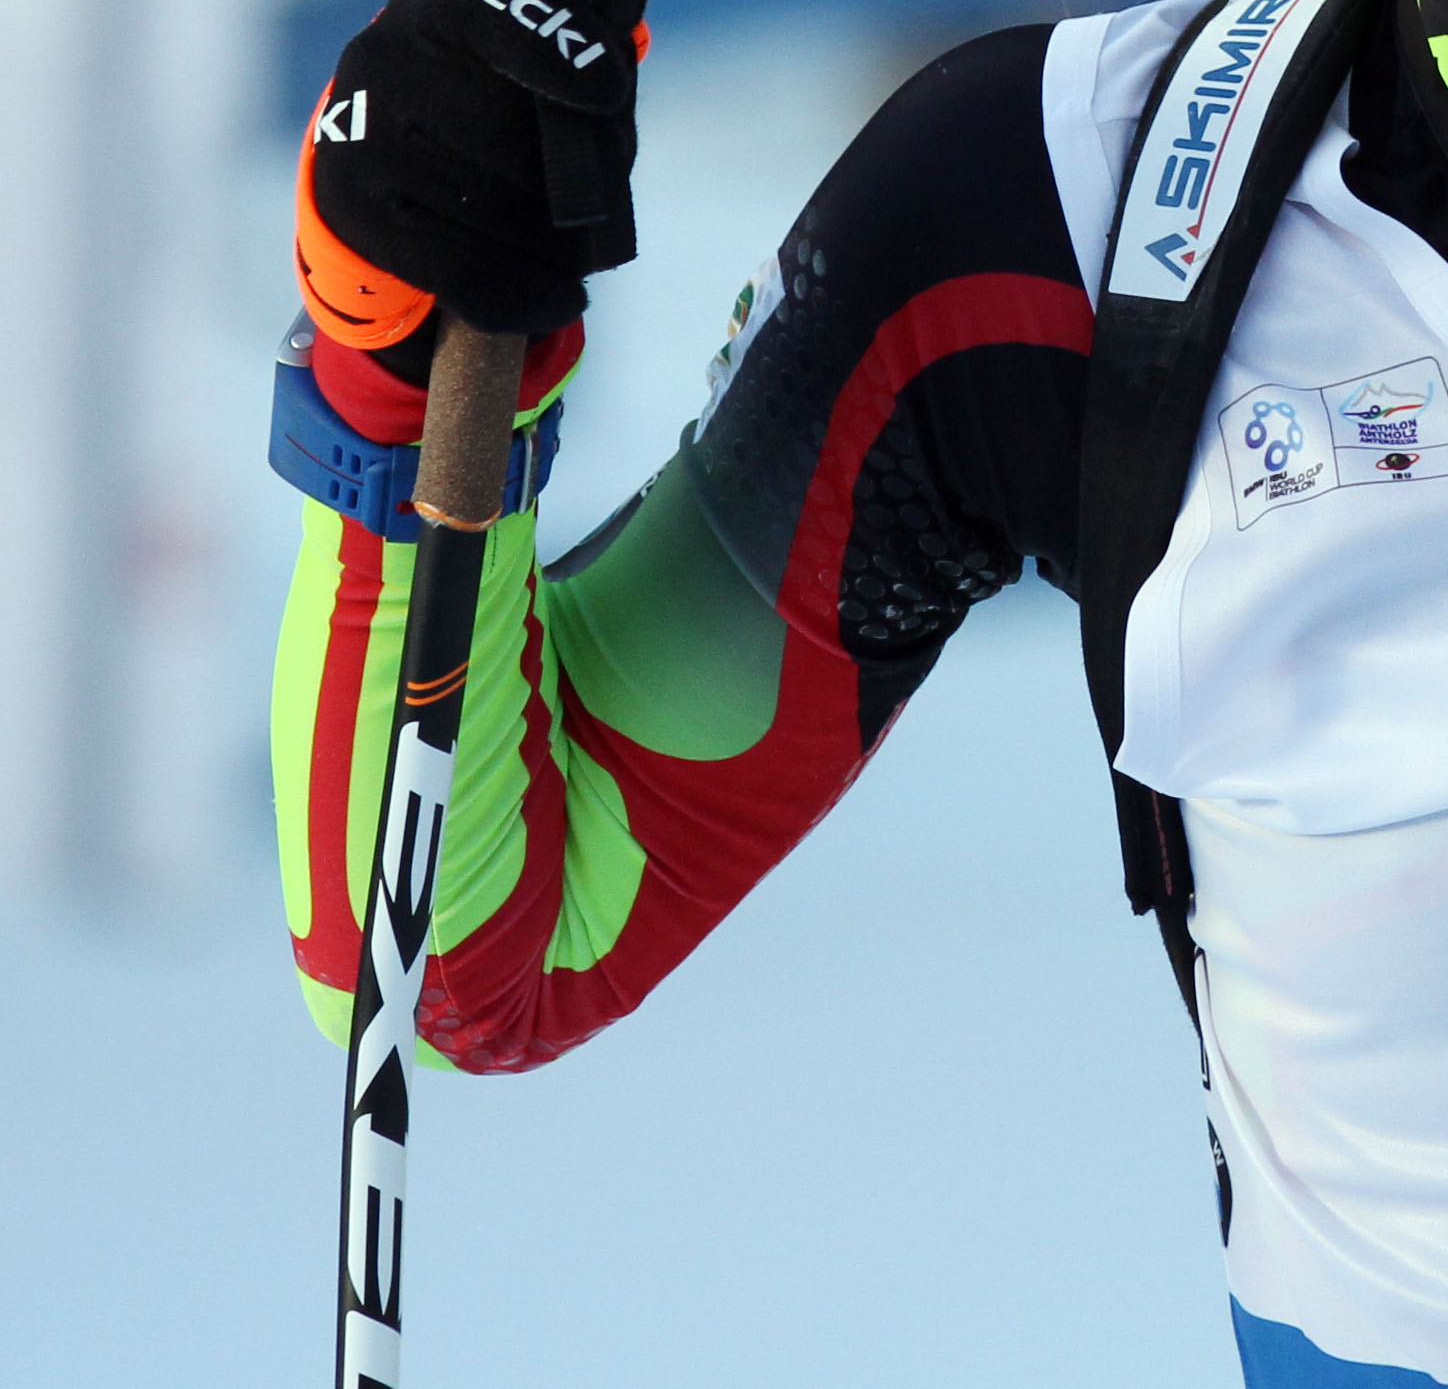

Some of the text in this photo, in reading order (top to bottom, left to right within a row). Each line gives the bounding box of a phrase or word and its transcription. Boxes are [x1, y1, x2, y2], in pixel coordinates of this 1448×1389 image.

[1359, 429, 1418, 440] ANTHOLZ
[1270, 462, 1324, 491] WORLD CUP
[1269, 478, 1316, 500] BIATHLON
